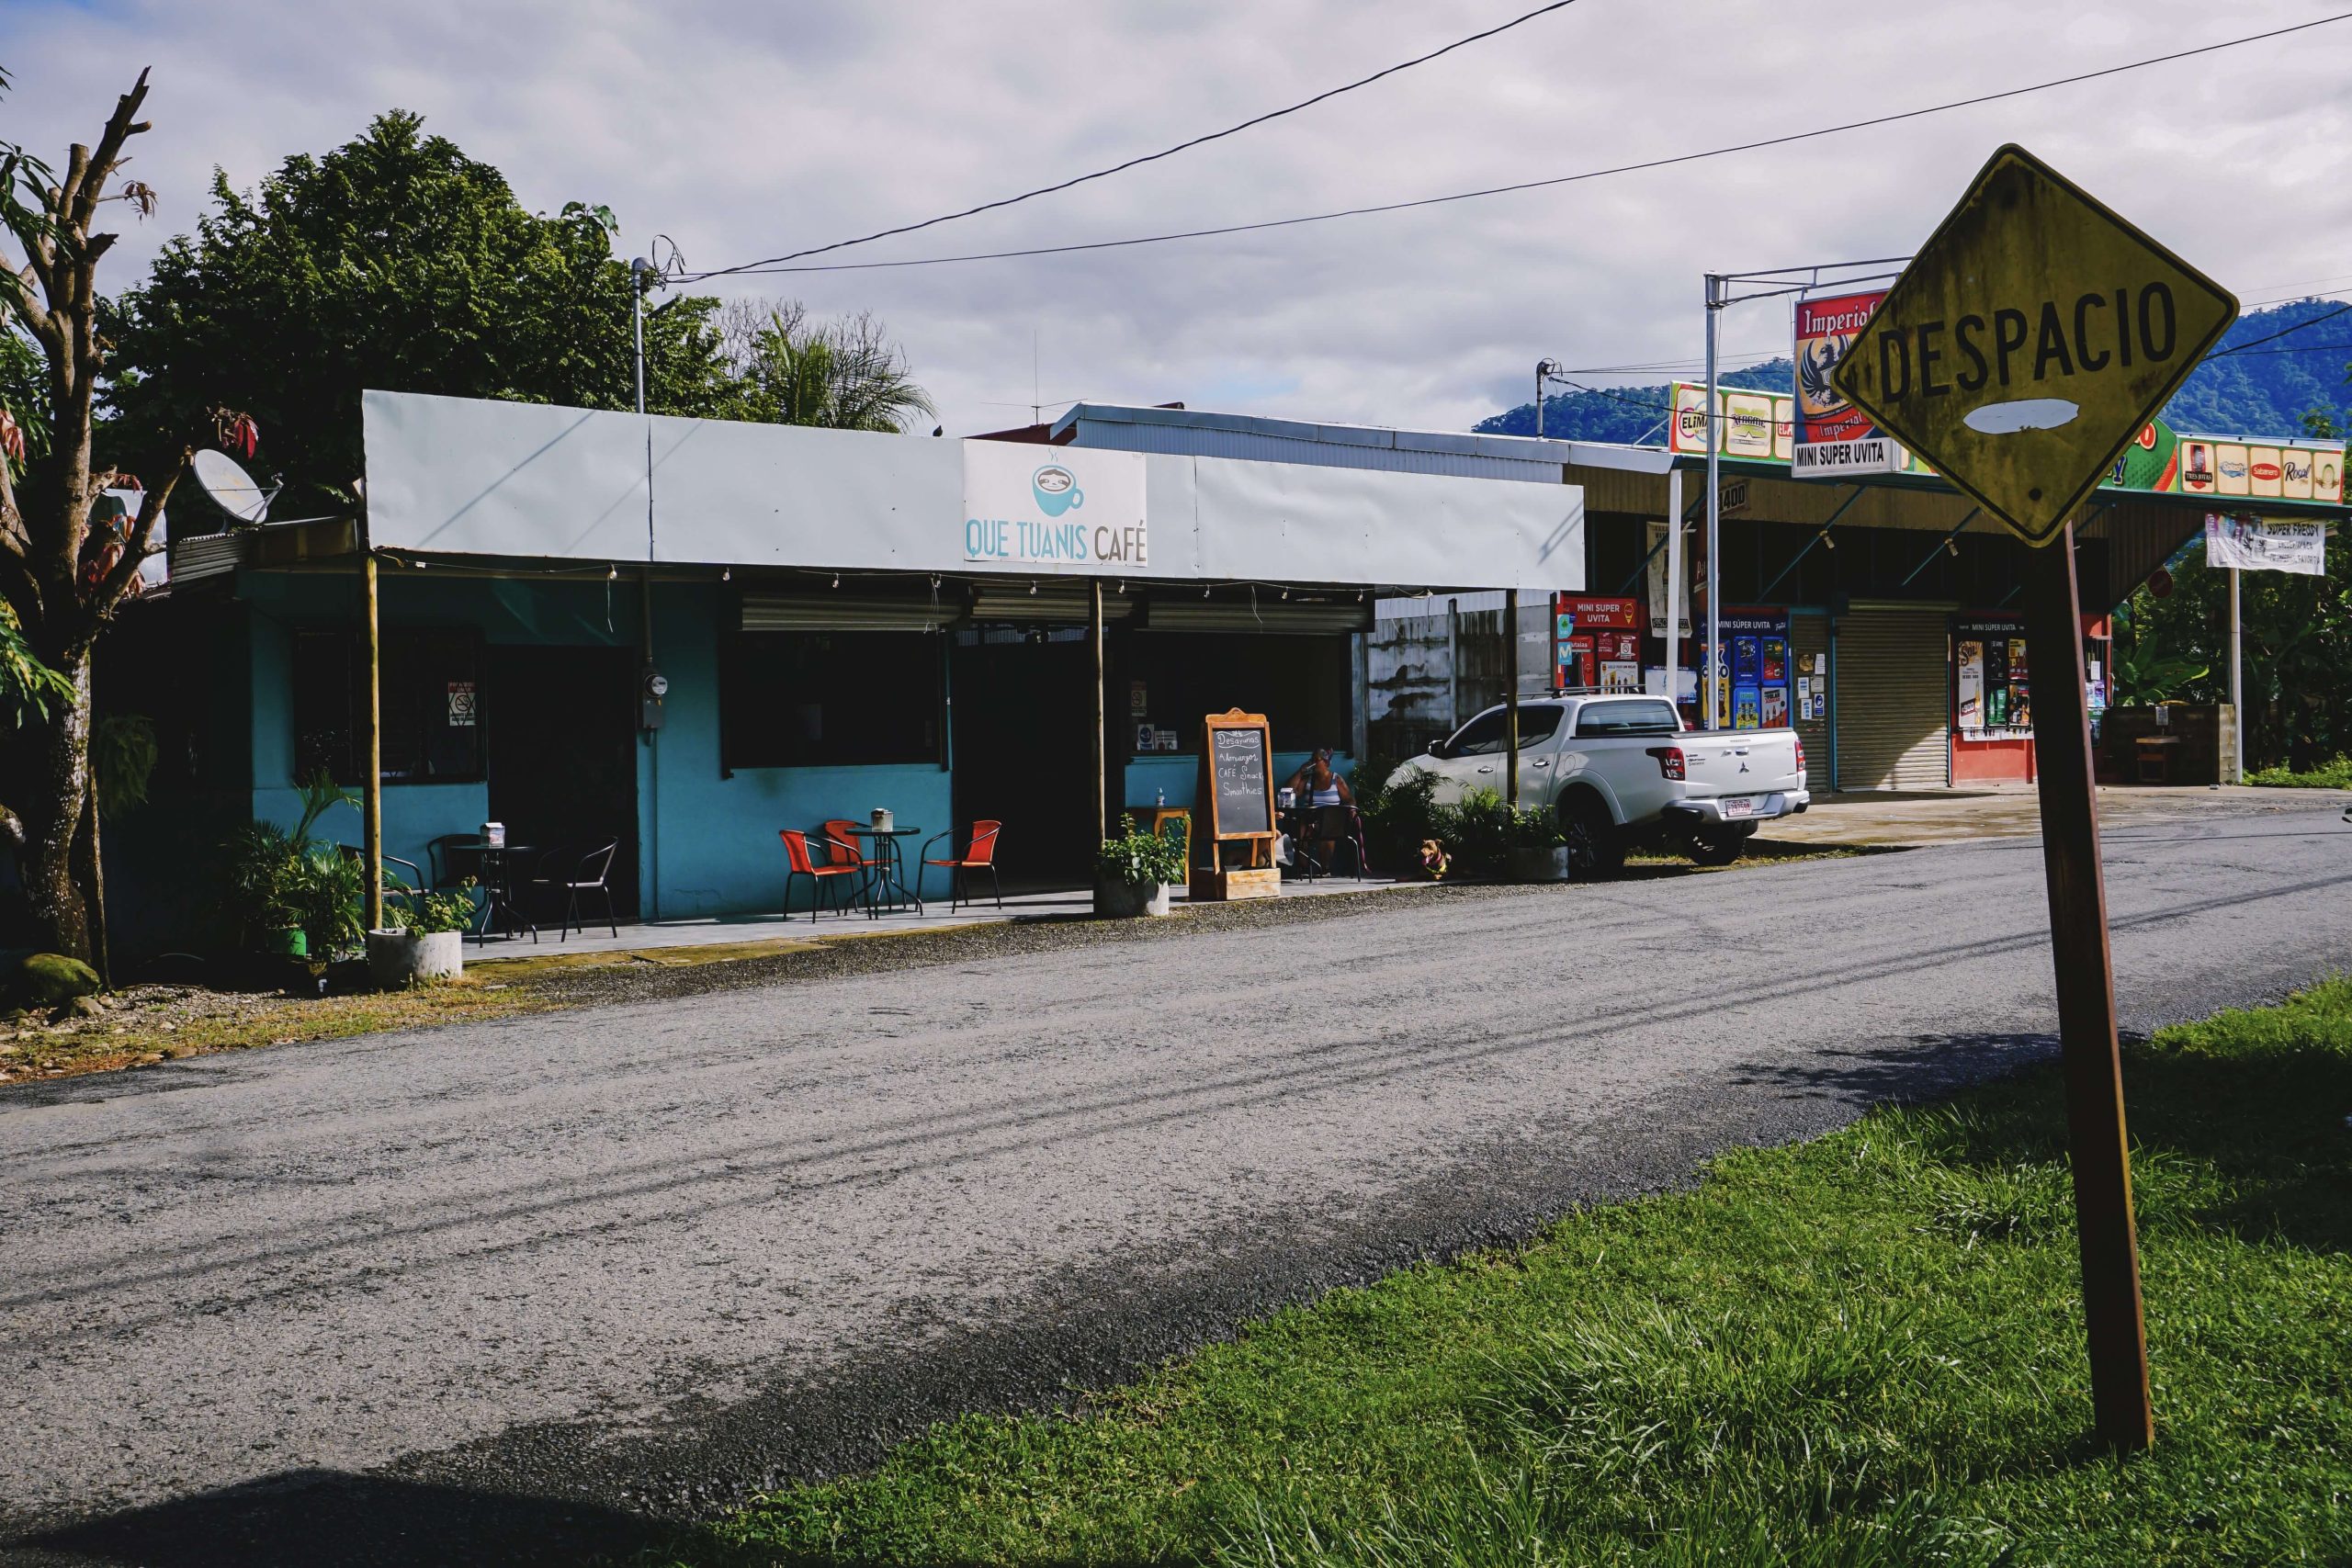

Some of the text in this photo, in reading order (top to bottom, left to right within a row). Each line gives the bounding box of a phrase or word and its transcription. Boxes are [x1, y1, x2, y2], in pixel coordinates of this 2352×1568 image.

[1804, 301, 1876, 338] Imperial
[1879, 281, 2176, 404] DESPACIO
[1796, 442, 1884, 468] MINI SUPER UVITA
[2253, 468, 2279, 479] Sabanero
[2284, 462, 2311, 481] Rosal
[966, 519, 1148, 562] QUE TUANIS CAFÉ
[1577, 604, 1621, 613] MINI SUPER
[1587, 614, 1611, 623] UVITA
[1752, 621, 1771, 629] UVITA
[1217, 733, 1261, 746] Desayunos
[1218, 765, 1237, 779] CAFÉ
[1223, 782, 1262, 795] Smoothies
